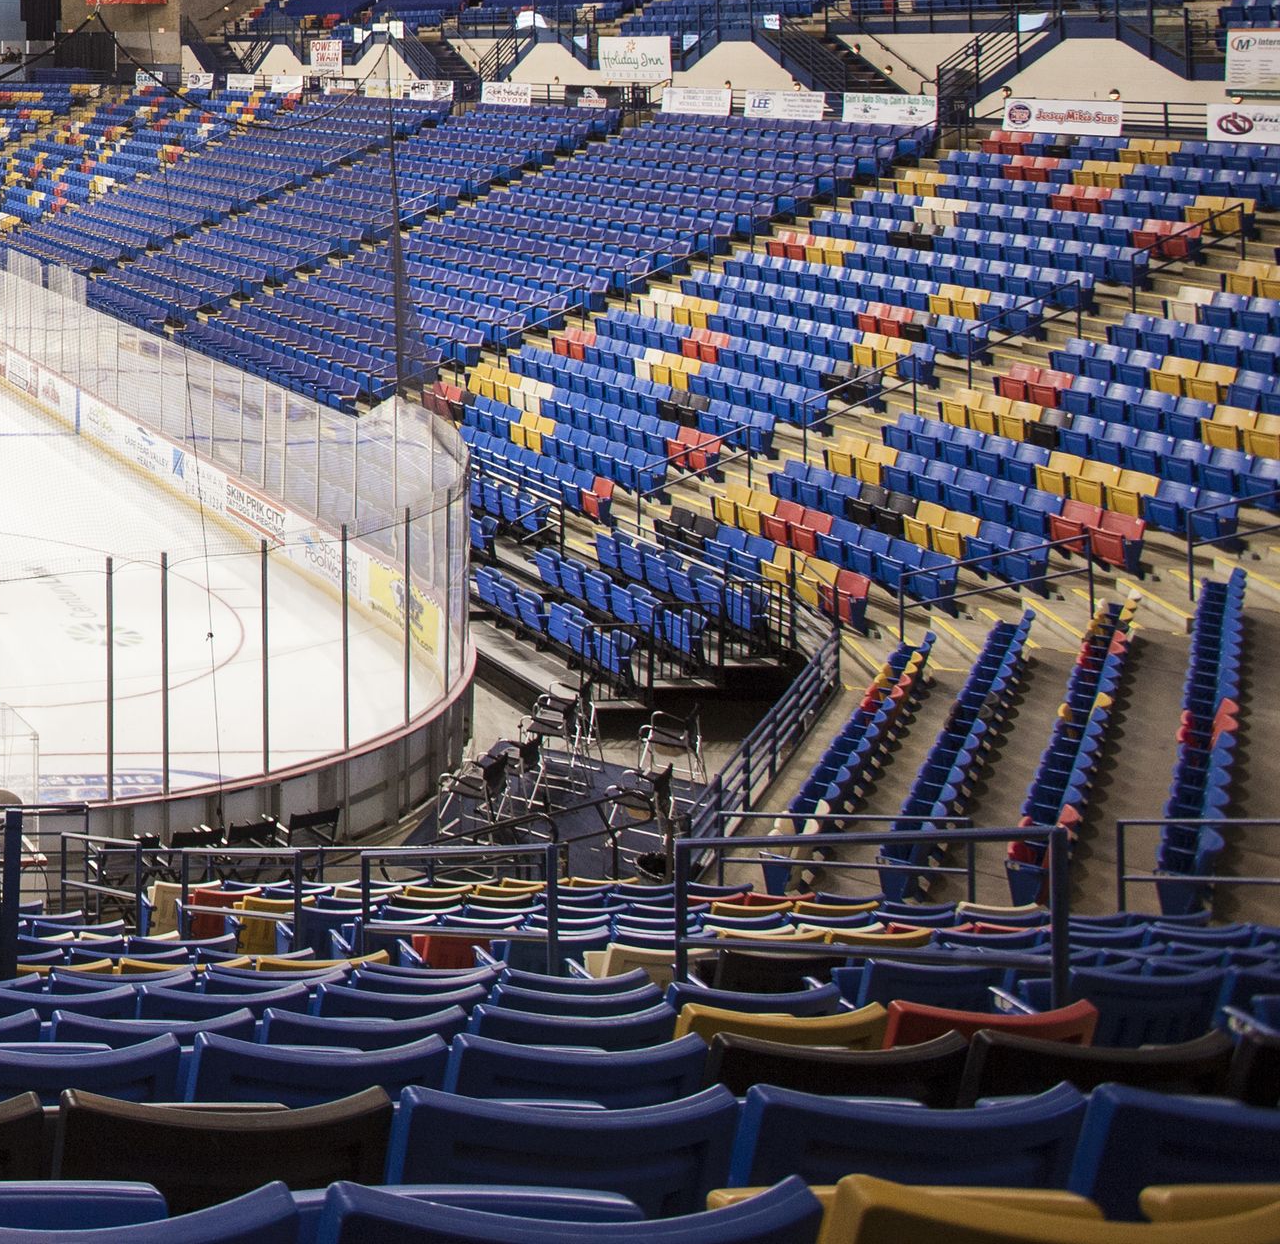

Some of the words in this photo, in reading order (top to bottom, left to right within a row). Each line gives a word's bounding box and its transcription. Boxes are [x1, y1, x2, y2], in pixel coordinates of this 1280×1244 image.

[311, 40, 341, 52] POWERS
[316, 52, 339, 62] SWAIN
[602, 51, 639, 69] Holiday
[641, 54, 663, 66] Inn
[752, 99, 770, 109] LEE
[861, 95, 874, 103] Auto
[875, 95, 888, 105] Shop
[907, 96, 920, 105] Auto
[921, 97, 935, 107] Shop
[1035, 108, 1066, 124] Jersey
[1066, 109, 1093, 123] Mike's
[149, 449, 169, 468] VALLEY
[226, 484, 245, 504] SKIN
[246, 495, 265, 517] PRIK
[266, 505, 286, 527] CITY
[226, 496, 251, 517] TATTOOS
